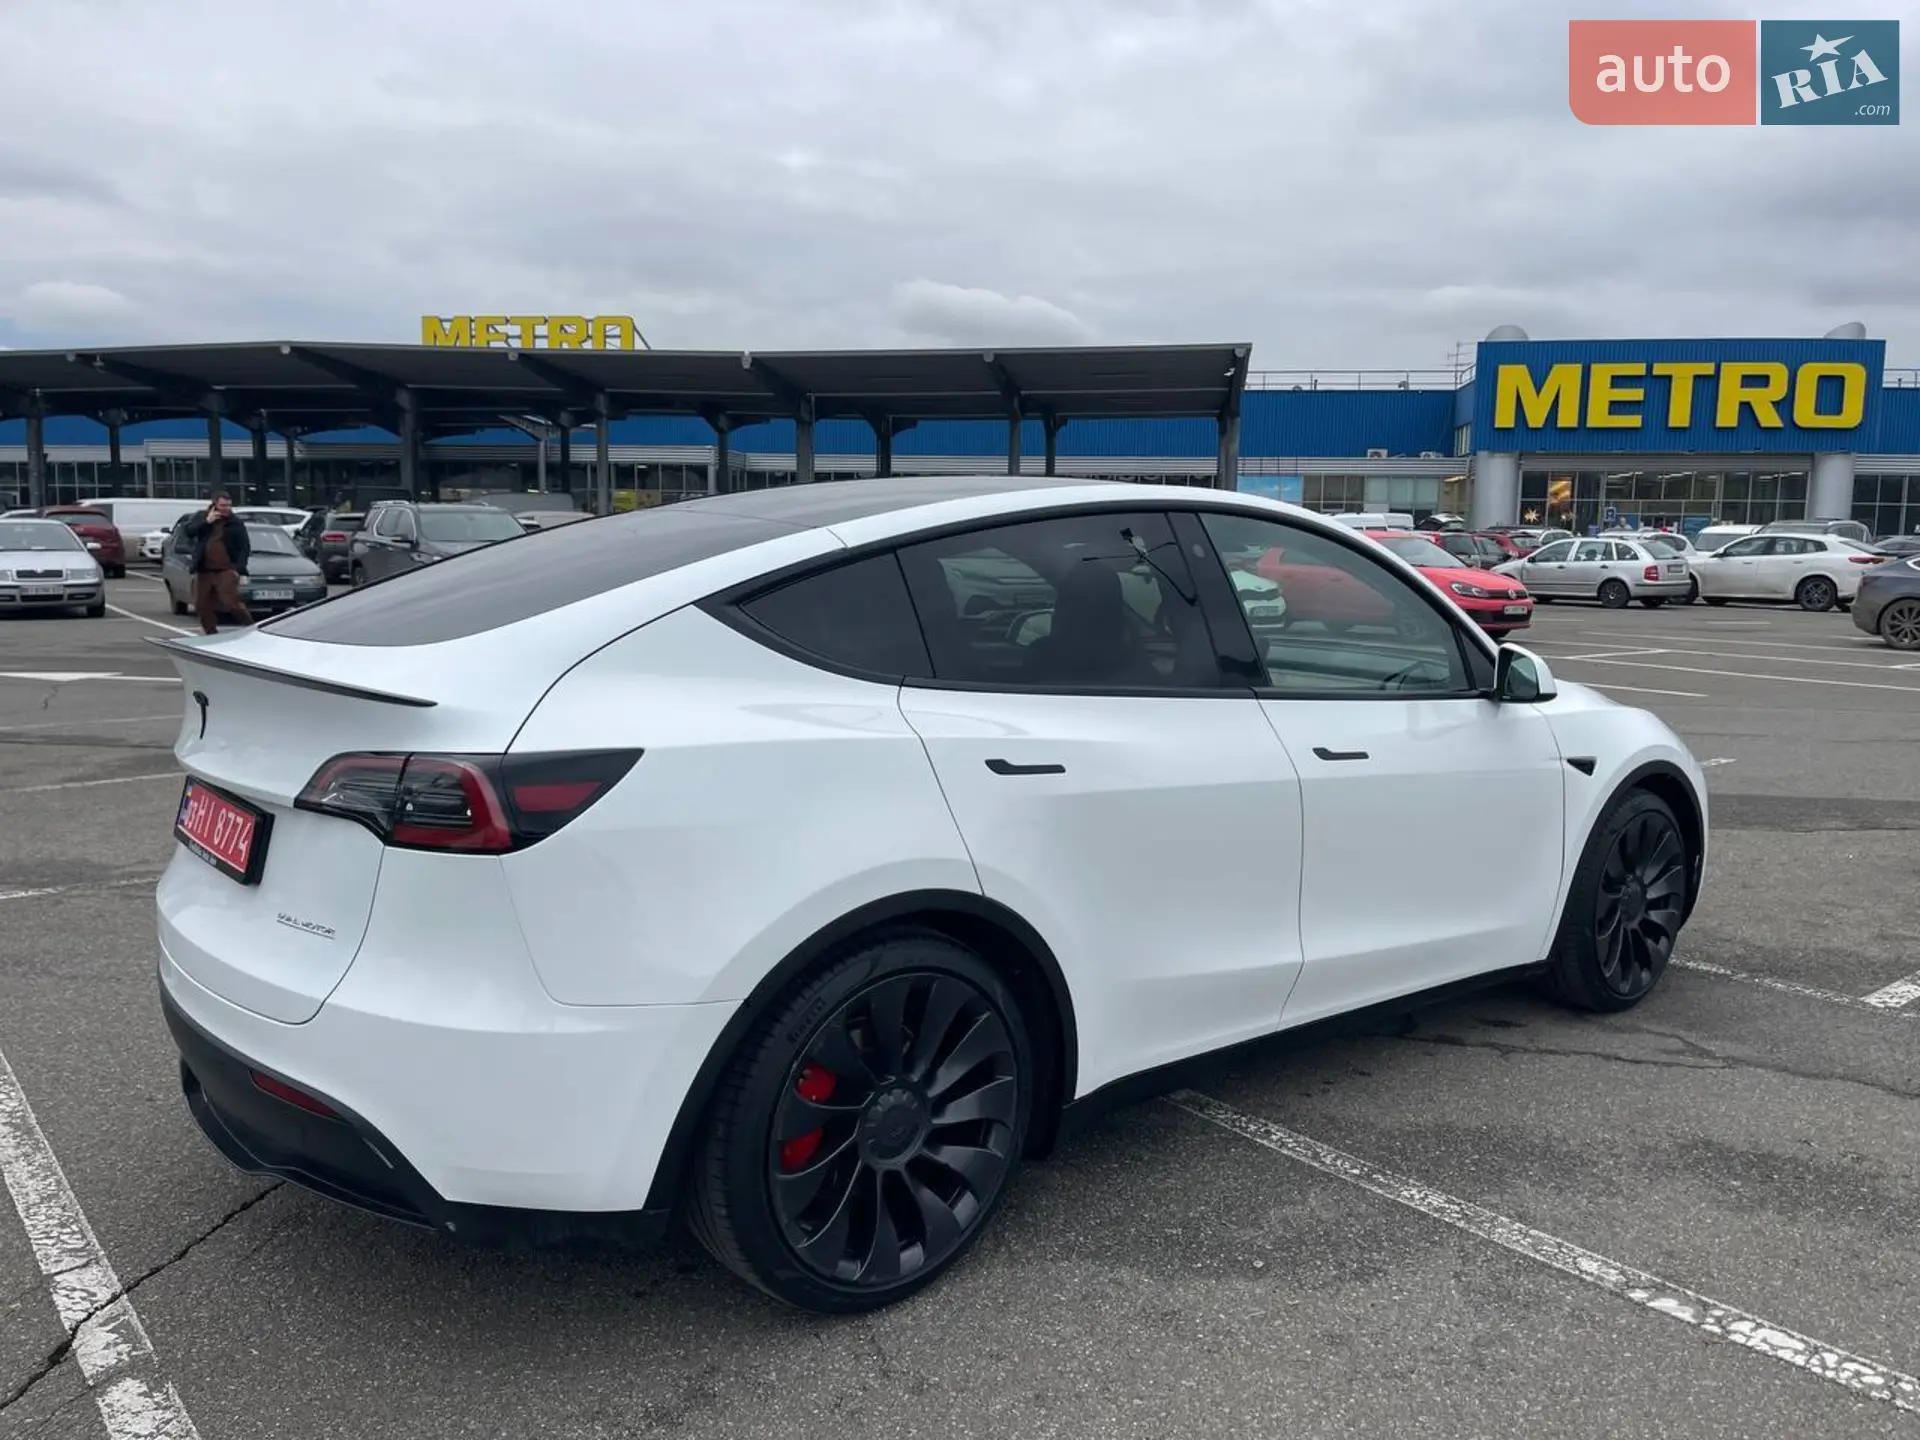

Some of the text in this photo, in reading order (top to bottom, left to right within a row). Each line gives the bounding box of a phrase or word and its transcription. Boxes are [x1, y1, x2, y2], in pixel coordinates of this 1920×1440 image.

[421, 315, 635, 350] METRO
[1494, 362, 1867, 429] METRO
[214, 807, 252, 863] 8774
